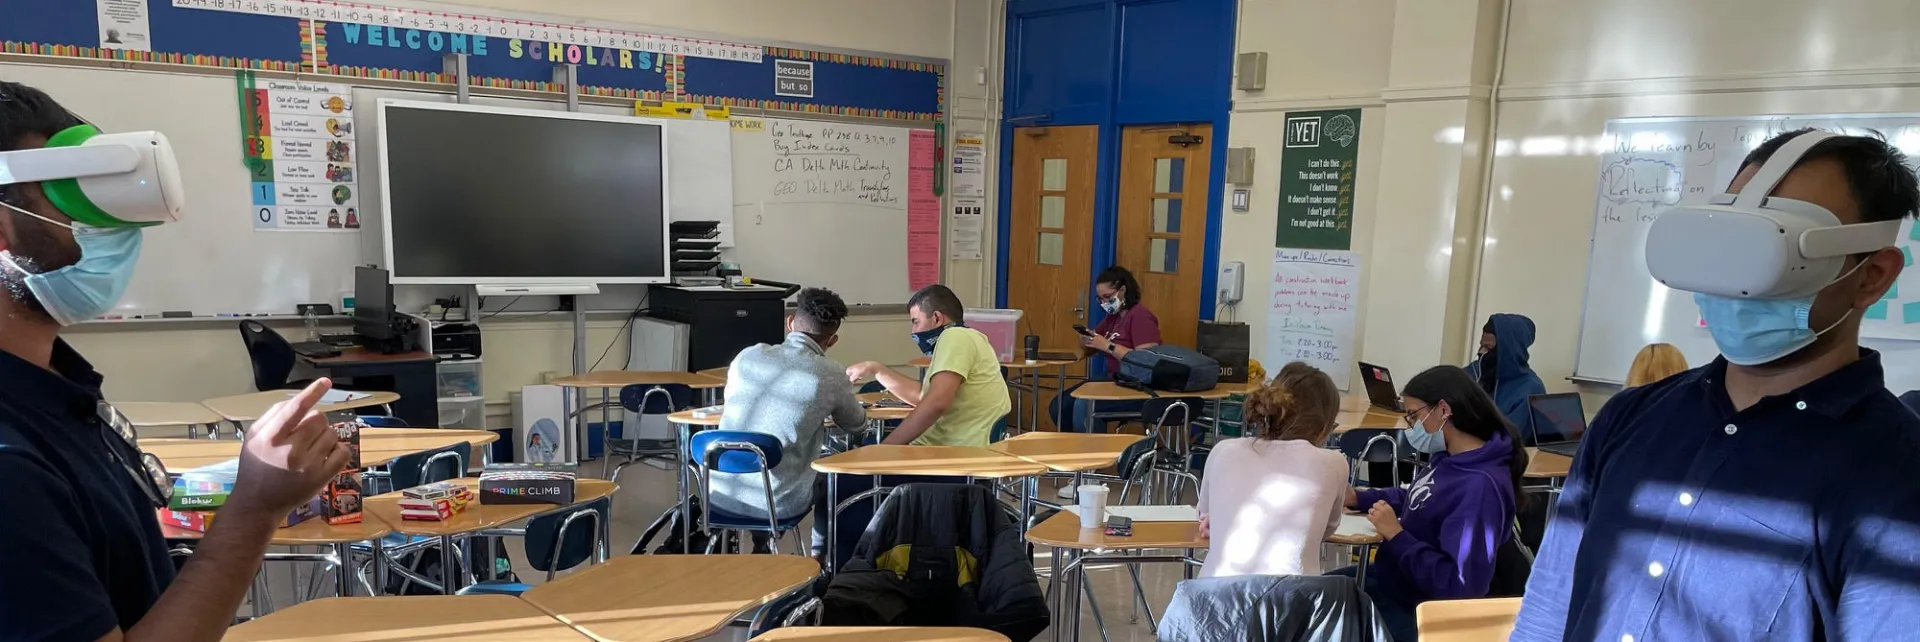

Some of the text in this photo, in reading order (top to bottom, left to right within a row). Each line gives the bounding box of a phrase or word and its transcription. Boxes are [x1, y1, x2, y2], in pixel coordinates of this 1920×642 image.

[228, 0, 241, 9] -17
[246, 2, 259, 12] -16
[263, 3, 276, 12] -15
[280, 5, 292, 14] -14
[297, 6, 310, 16] -13
[314, 8, 326, 18] -12
[330, 10, 340, 19] -11
[346, 12, 358, 20] -10
[363, 13, 373, 22] -9
[380, 14, 389, 24] -8
[394, 16, 404, 24] -7
[410, 18, 419, 27] -6
[425, 19, 434, 28] -5
[440, 21, 448, 29] -4
[454, 22, 464, 32] -3
[470, 23, 478, 32] -2
[500, 26, 506, 36] 0
[530, 30, 535, 38] 2
[544, 31, 548, 40] 3
[556, 32, 562, 40] 4
[570, 33, 575, 42] 5
[584, 34, 588, 43] 6
[610, 36, 615, 46] 8
[622, 38, 628, 46] 9
[634, 39, 641, 48] 10
[646, 40, 652, 50] 11
[658, 42, 666, 52] 12
[672, 44, 678, 52] 13
[683, 45, 690, 54] 14
[695, 46, 702, 55] 15
[706, 47, 714, 56] 16
[718, 48, 726, 57] 17
[730, 48, 736, 58] 18
[742, 50, 748, 59] 19
[752, 52, 761, 60] 20
[342, 22, 664, 74] WELCOME SCHOLARS!
[776, 64, 811, 77] because
[780, 81, 795, 90] but
[730, 120, 744, 128] OME
[1296, 122, 1318, 142] YET
[774, 139, 790, 156] Buy
[794, 140, 820, 151] Index
[1614, 133, 1636, 154] We
[1698, 130, 1716, 166] by
[774, 158, 792, 172] CA
[1311, 159, 1322, 168] can't
[1323, 160, 1330, 168] do
[1330, 159, 1340, 168] this
[1299, 171, 1308, 180] This
[1309, 171, 1326, 180] doesn't
[1327, 172, 1338, 180] work
[261, 184, 266, 200] 1
[1312, 184, 1324, 192] don't
[1690, 185, 1705, 194] on
[1292, 195, 1309, 204] doesn't
[1310, 196, 1322, 204] make
[260, 208, 271, 223] 0
[1310, 208, 1322, 216] don't
[1322, 208, 1331, 218] get
[1602, 208, 1628, 222] the
[756, 214, 762, 226] 2
[1307, 219, 1319, 228] good
[1326, 219, 1334, 228] this
[1340, 293, 1351, 302] up
[1274, 299, 1292, 316] during
[334, 422, 357, 439] enga
[492, 486, 560, 496] PRIME CLIMB
